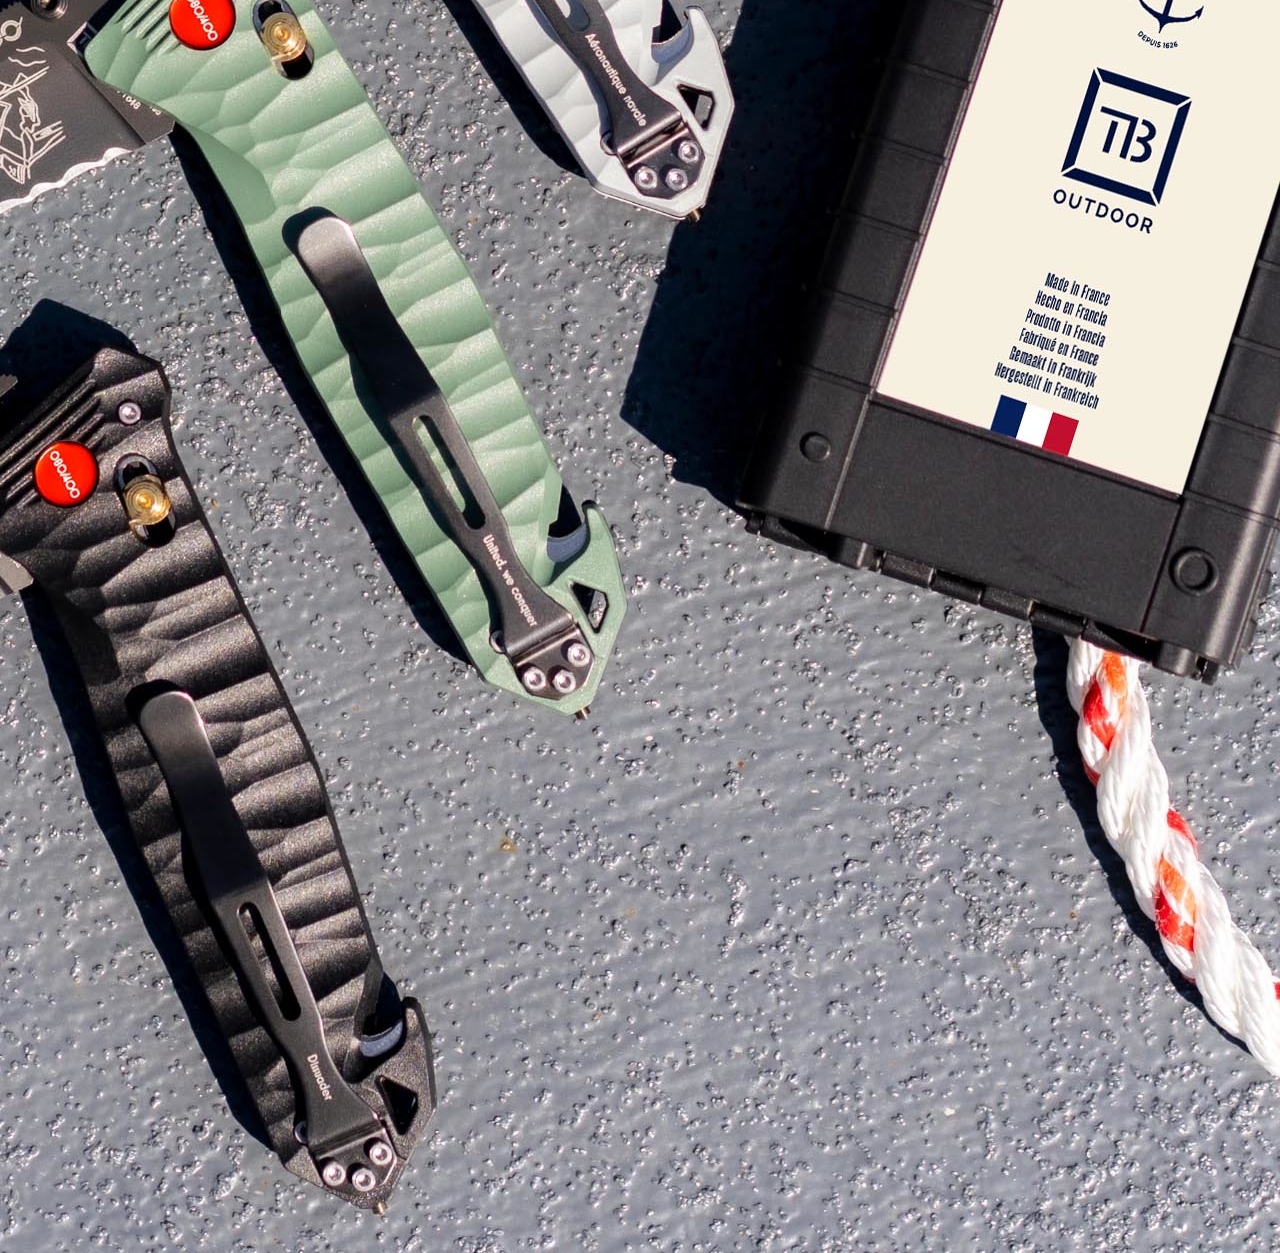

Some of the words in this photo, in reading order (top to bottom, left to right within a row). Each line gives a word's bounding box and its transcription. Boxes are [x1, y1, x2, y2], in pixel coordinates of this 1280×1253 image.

[1137, 30, 1162, 48] DEPUIS
[1162, 41, 1179, 49] 1626
[585, 33, 627, 95] Aéronautique
[623, 95, 647, 127] navale
[1053, 188, 1154, 234] OUTDOOR
[1034, 290, 1062, 311] Hecho
[1062, 301, 1075, 316] en
[1075, 303, 1108, 327] Francia
[1044, 272, 1069, 293] Made
[1070, 280, 1080, 297] in
[1080, 284, 1111, 307] France
[1018, 327, 1057, 352] Fabriqué
[1057, 342, 1070, 356] en
[1070, 344, 1100, 367] France
[1024, 308, 1061, 333] Prodotto
[1062, 320, 1073, 336] in
[1073, 324, 1106, 348] Francia
[994, 361, 1042, 390] Hergestellt
[1042, 377, 1053, 394] in
[1053, 381, 1100, 410] Frankreich
[1008, 345, 1047, 371] Gemaakt
[1047, 358, 1058, 374] in
[1058, 362, 1098, 388] Frankrijk
[49, 449, 80, 499] 080/400
[502, 569, 514, 586] we
[511, 587, 538, 627] conquer
